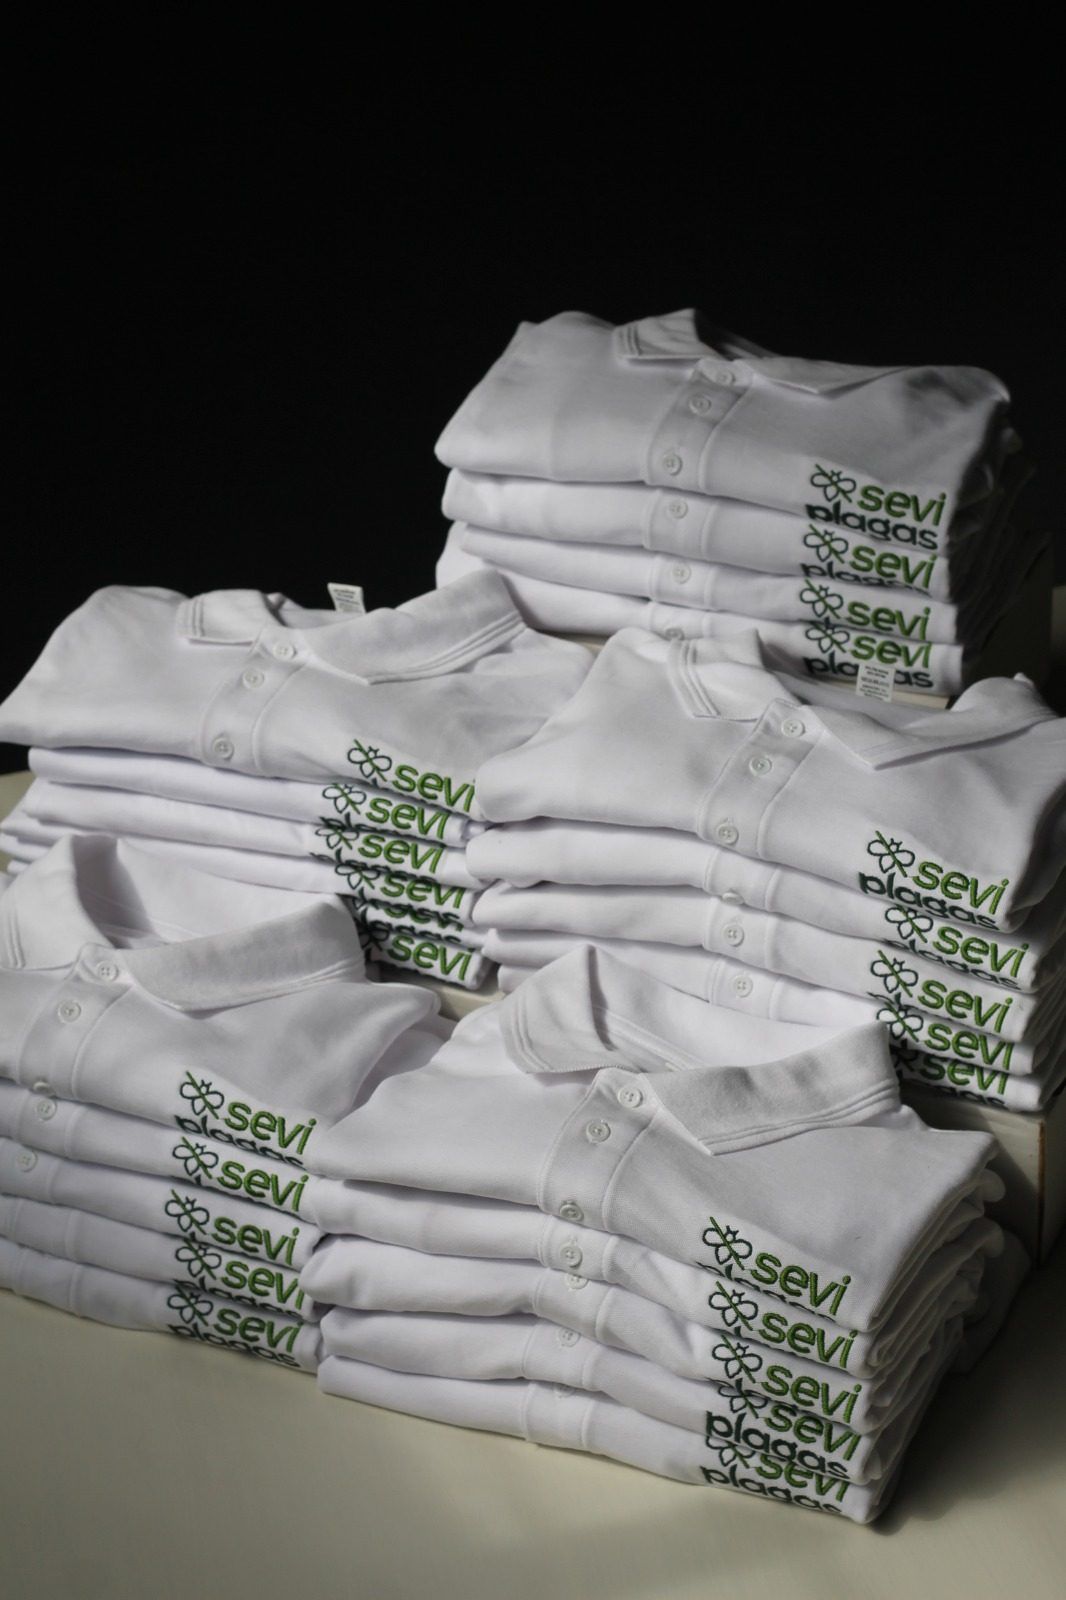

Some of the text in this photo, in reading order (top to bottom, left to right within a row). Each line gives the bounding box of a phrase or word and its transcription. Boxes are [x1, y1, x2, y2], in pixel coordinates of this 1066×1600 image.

[805, 500, 939, 551] plagas
[857, 484, 948, 527] sevi
[849, 544, 938, 589] sevi
[847, 601, 931, 641] sevi
[803, 651, 935, 689] plaas
[851, 634, 934, 669] sevi
[391, 763, 476, 813] sevi
[365, 797, 451, 841] sevi
[357, 833, 444, 875] sevi
[380, 872, 466, 910] sevi
[859, 871, 1001, 931] plagas
[912, 861, 1009, 916] sevi
[387, 934, 476, 982] sevi
[932, 925, 1030, 978] sevi
[917, 979, 1014, 1034] sevi
[924, 1023, 1015, 1070] sevi
[223, 1101, 317, 1155] sevi
[217, 1160, 309, 1213] sevi
[211, 1216, 300, 1266] sevi
[750, 1252, 851, 1315] sevi
[213, 1308, 304, 1354] sevi
[759, 1312, 859, 1368] sevi
[761, 1364, 862, 1424] sevi
[705, 1411, 851, 1478] plagas
[765, 1403, 862, 1461] sevi
